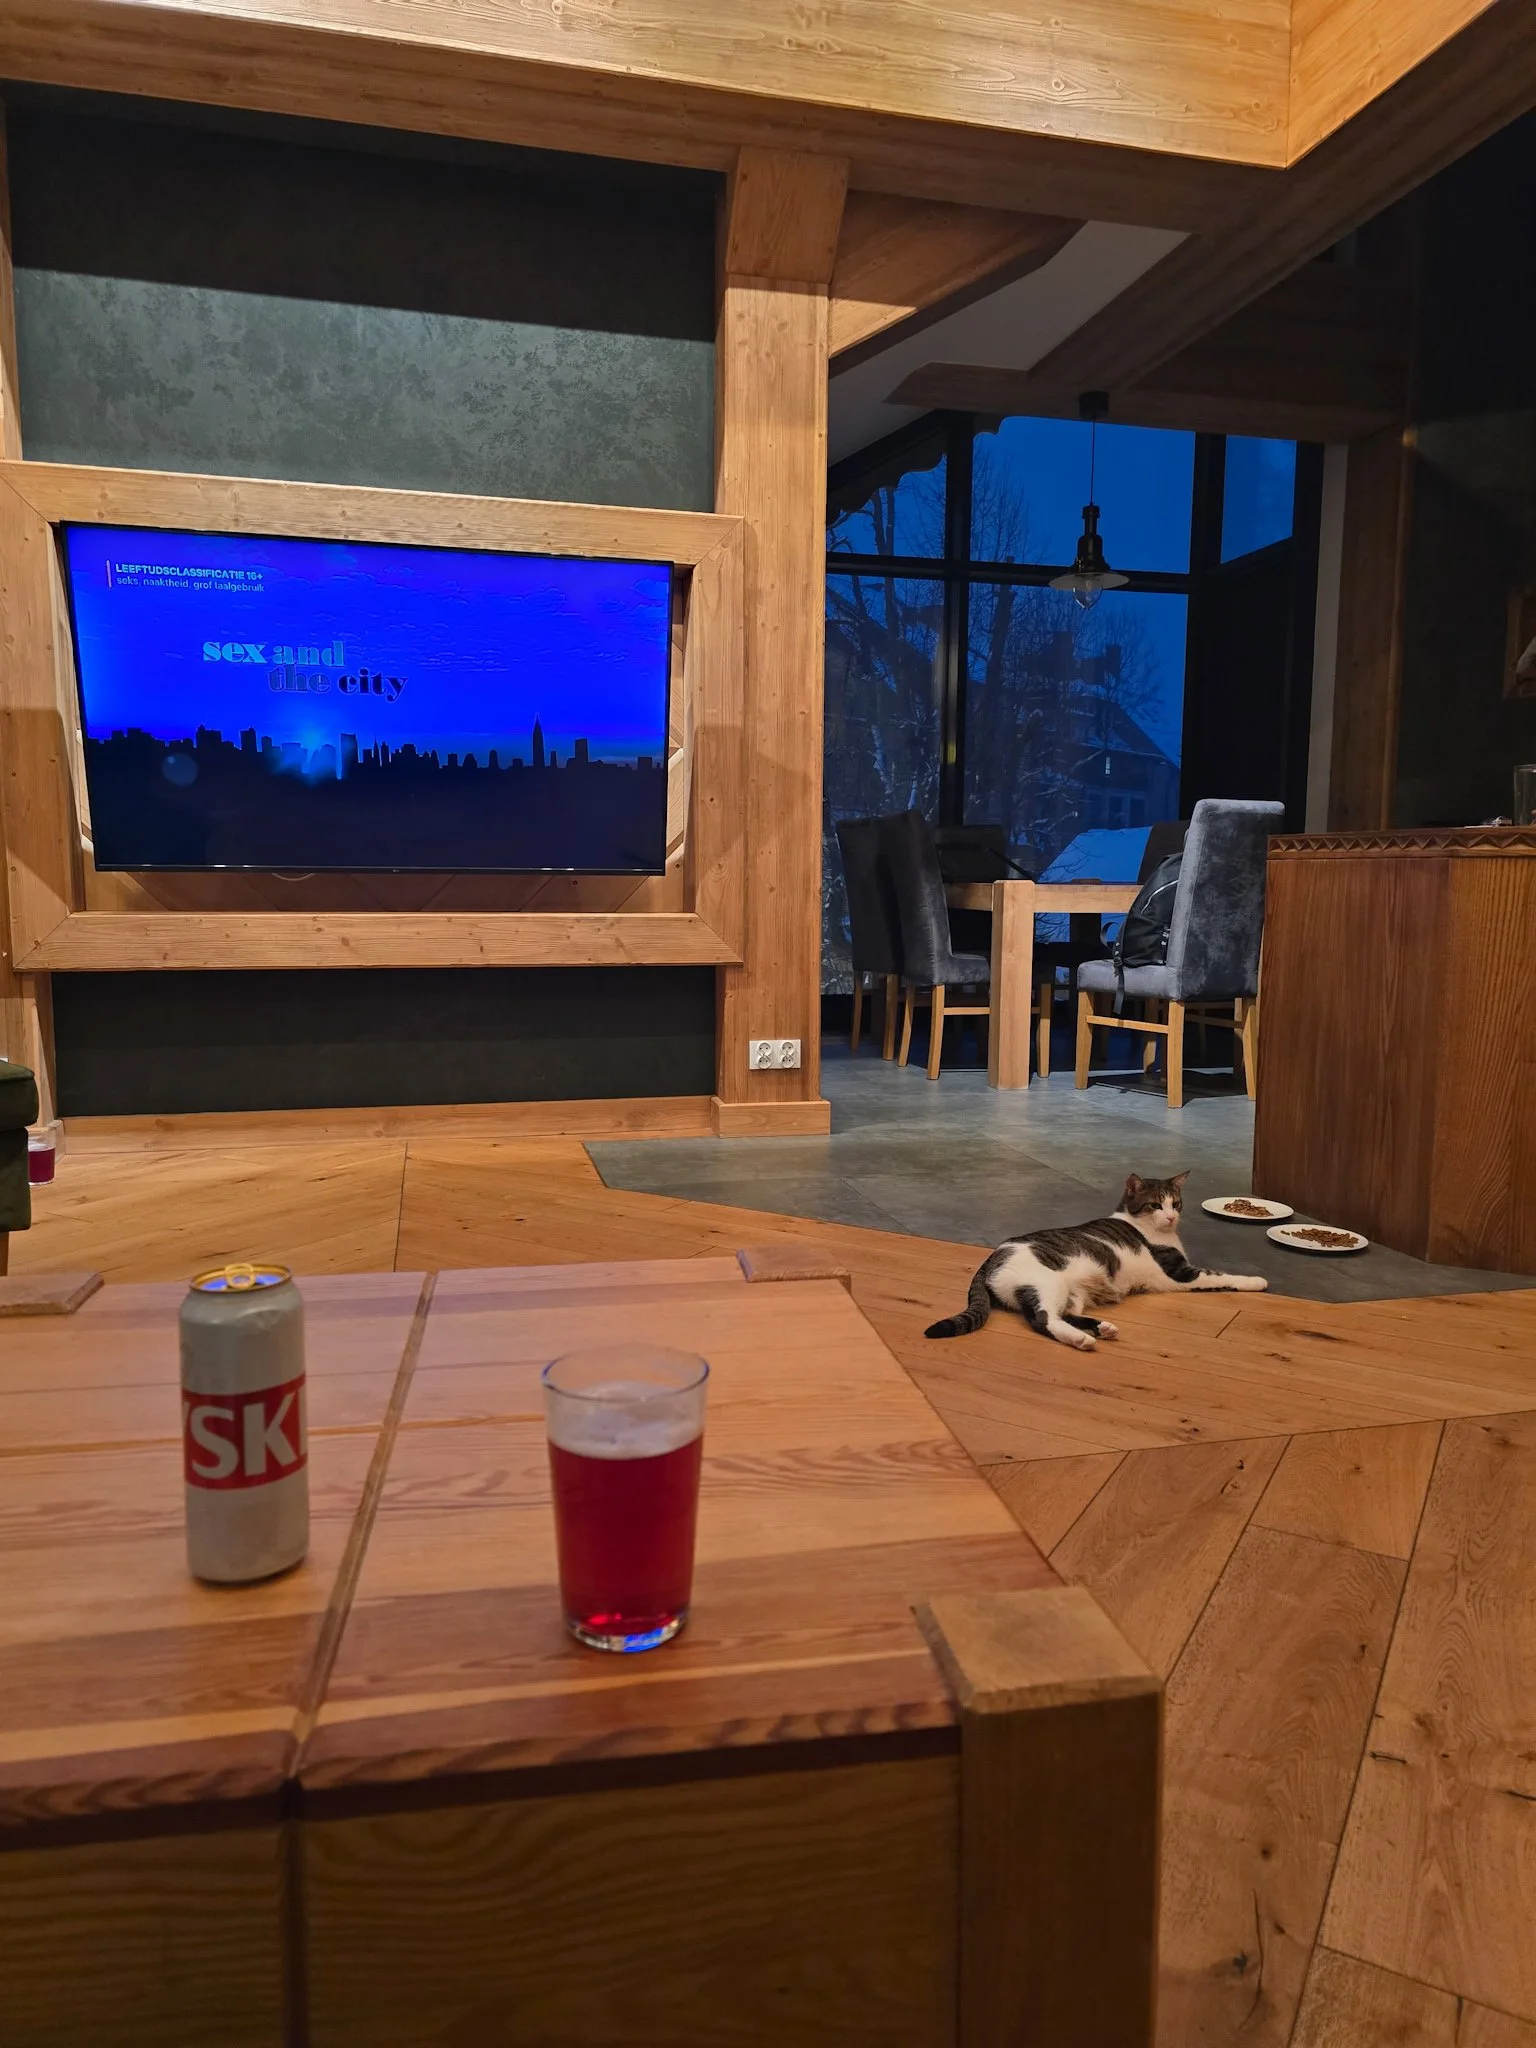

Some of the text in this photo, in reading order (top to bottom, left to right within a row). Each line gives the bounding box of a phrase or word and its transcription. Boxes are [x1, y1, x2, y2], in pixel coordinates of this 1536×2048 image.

[193, 580, 213, 591] grof
[214, 581, 265, 593] taalgebruik
[203, 640, 345, 667] sex and
[268, 664, 409, 703] the city
